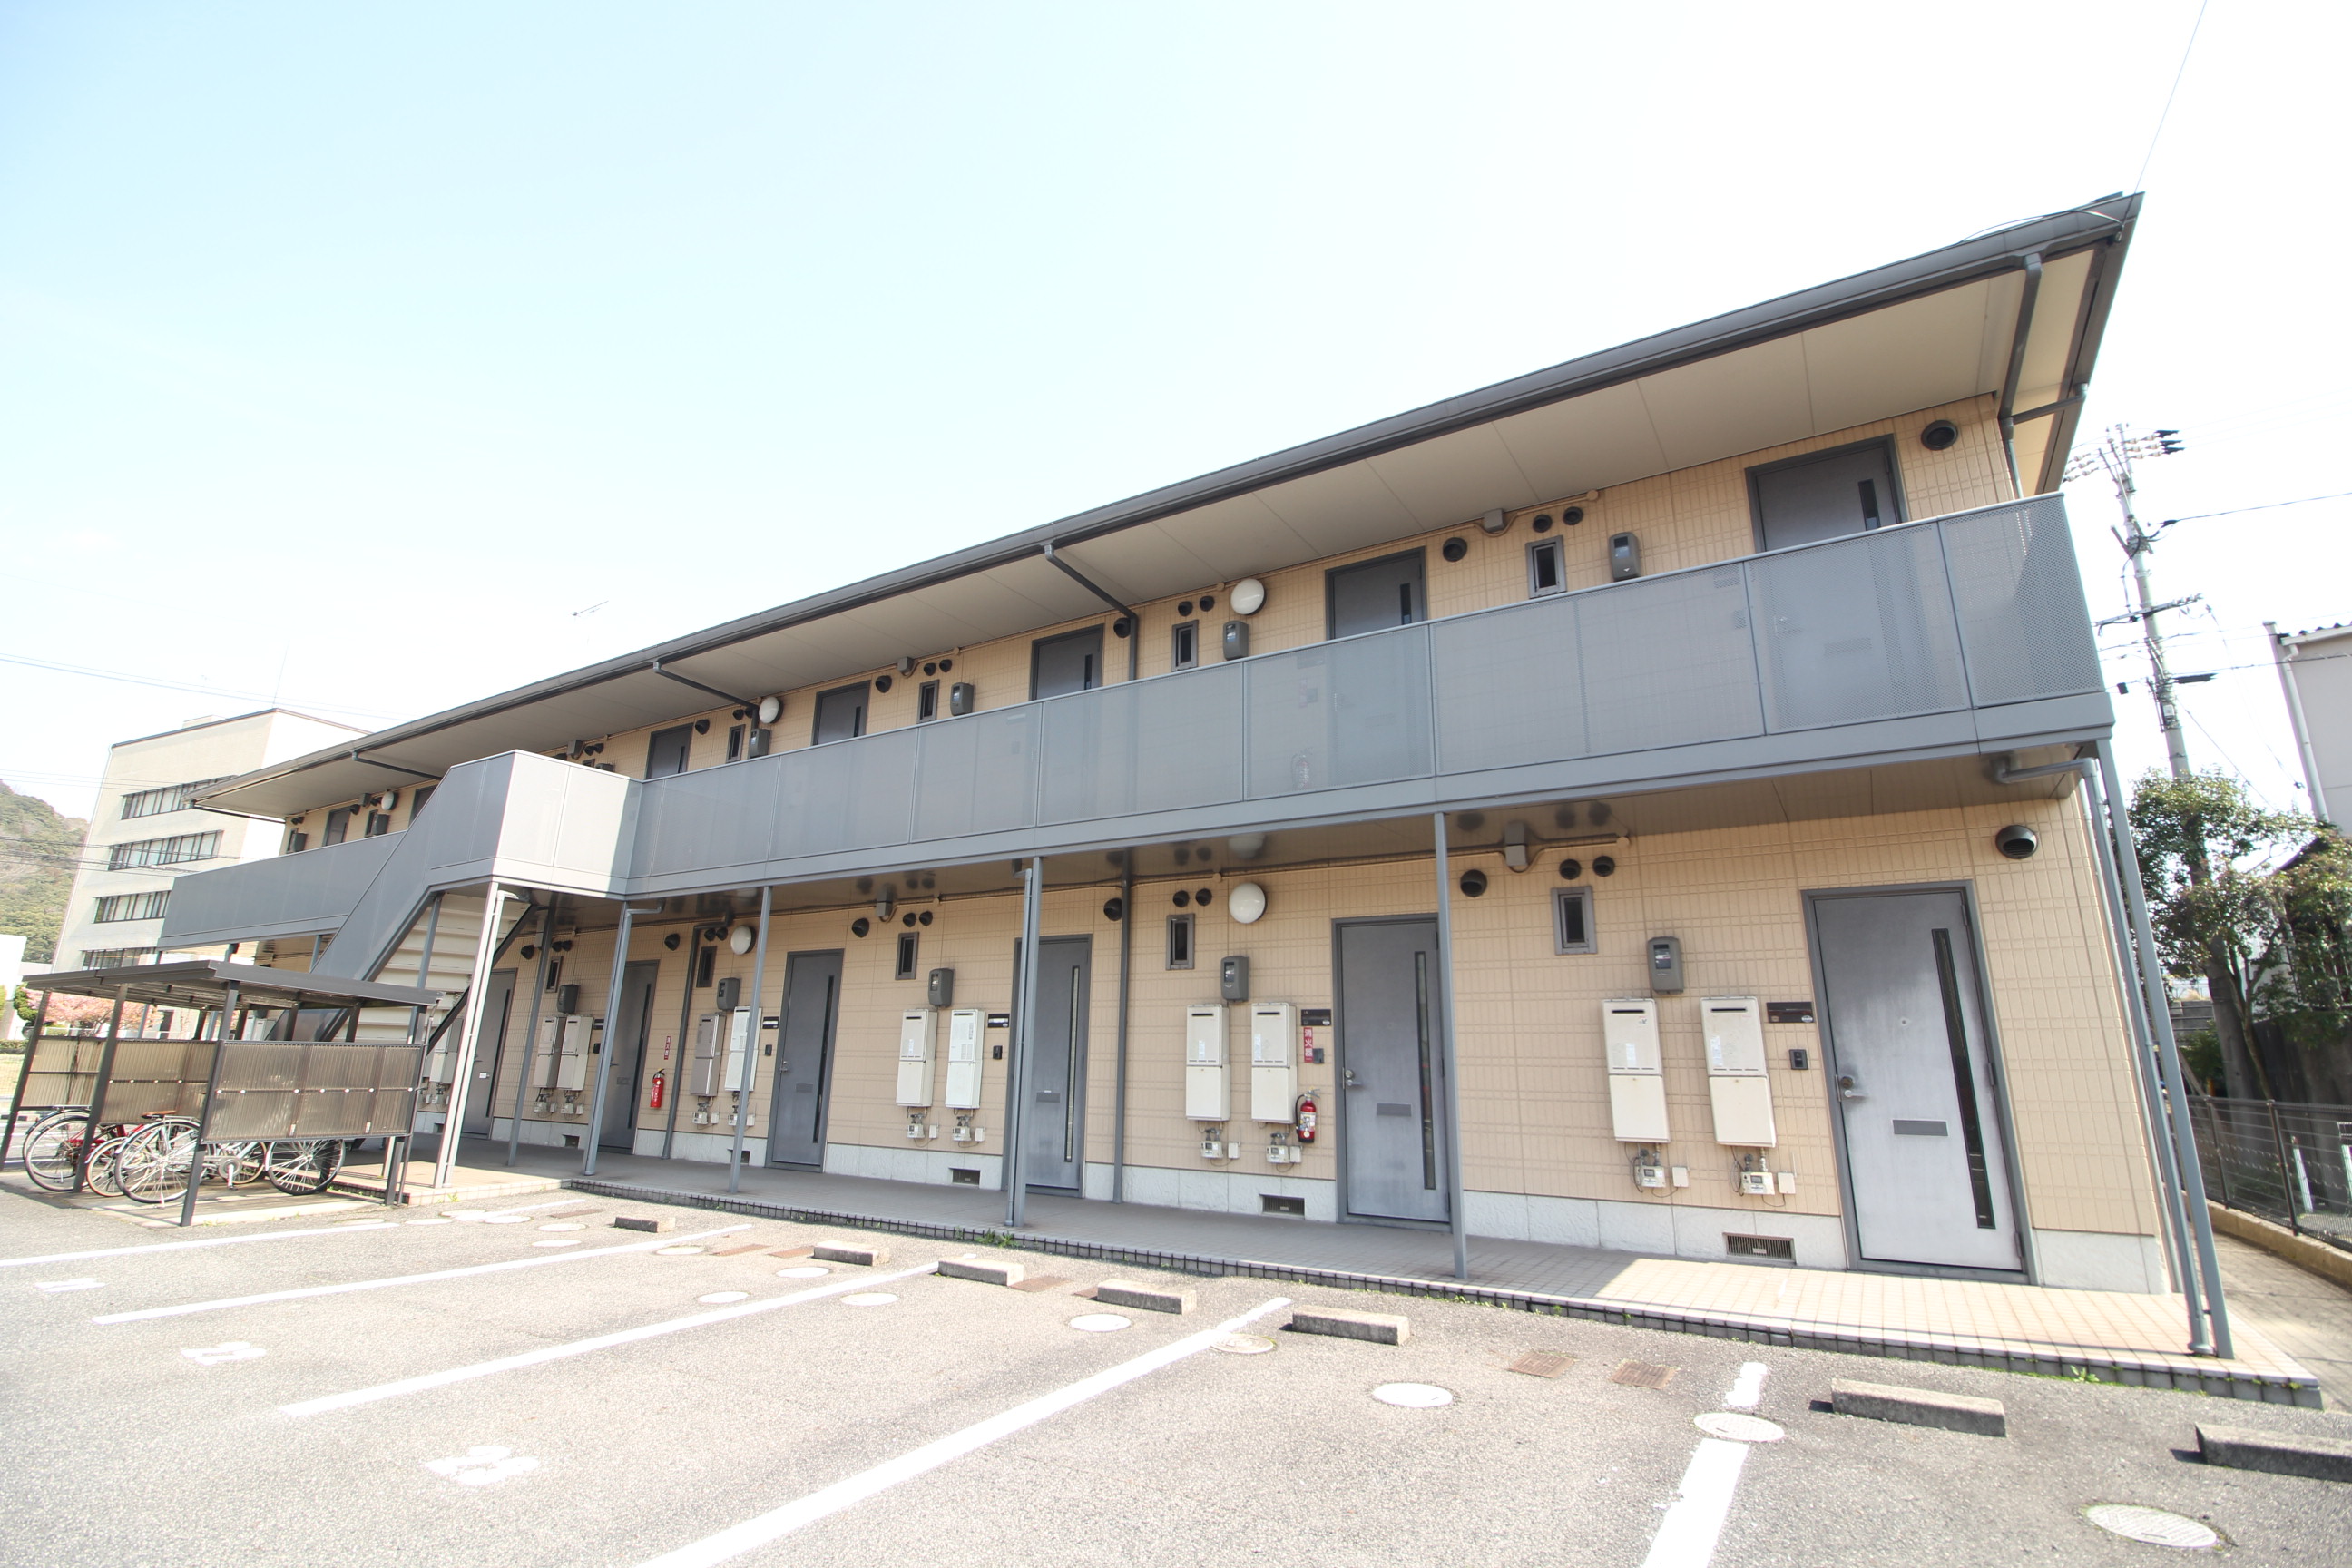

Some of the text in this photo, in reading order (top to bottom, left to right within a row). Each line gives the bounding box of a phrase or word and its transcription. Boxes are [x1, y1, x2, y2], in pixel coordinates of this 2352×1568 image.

[1304, 1027, 1313, 1057] 消火器
[181, 1341, 266, 1366] 22
[424, 1445, 540, 1486] 23
